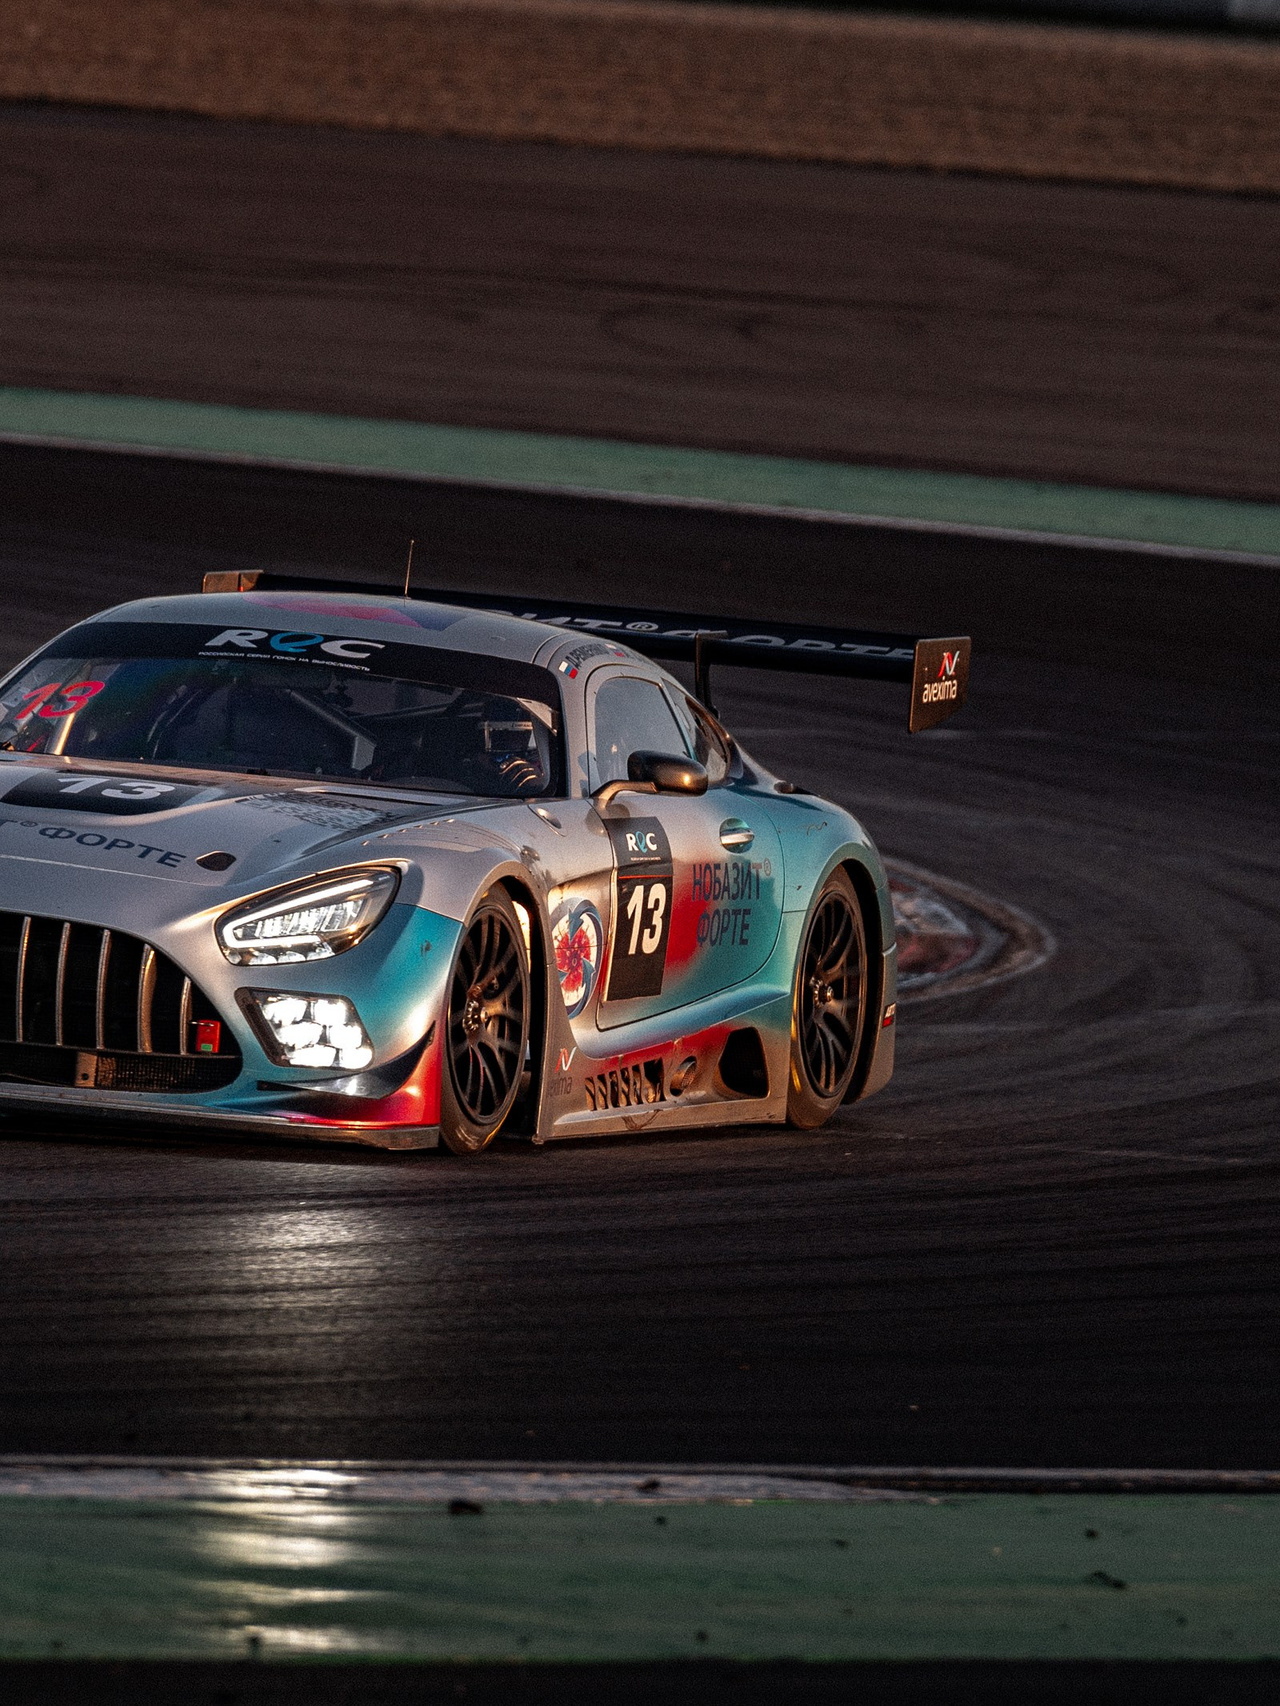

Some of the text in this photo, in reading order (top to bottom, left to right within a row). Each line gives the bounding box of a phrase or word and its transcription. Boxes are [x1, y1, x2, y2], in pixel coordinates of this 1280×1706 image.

[15, 681, 105, 720] 13
[922, 676, 957, 703] avexima
[57, 778, 175, 800] 13
[38, 826, 187, 868] ФОРТЕ
[627, 883, 666, 955] 13
[696, 908, 751, 948] ФОРТЕ
